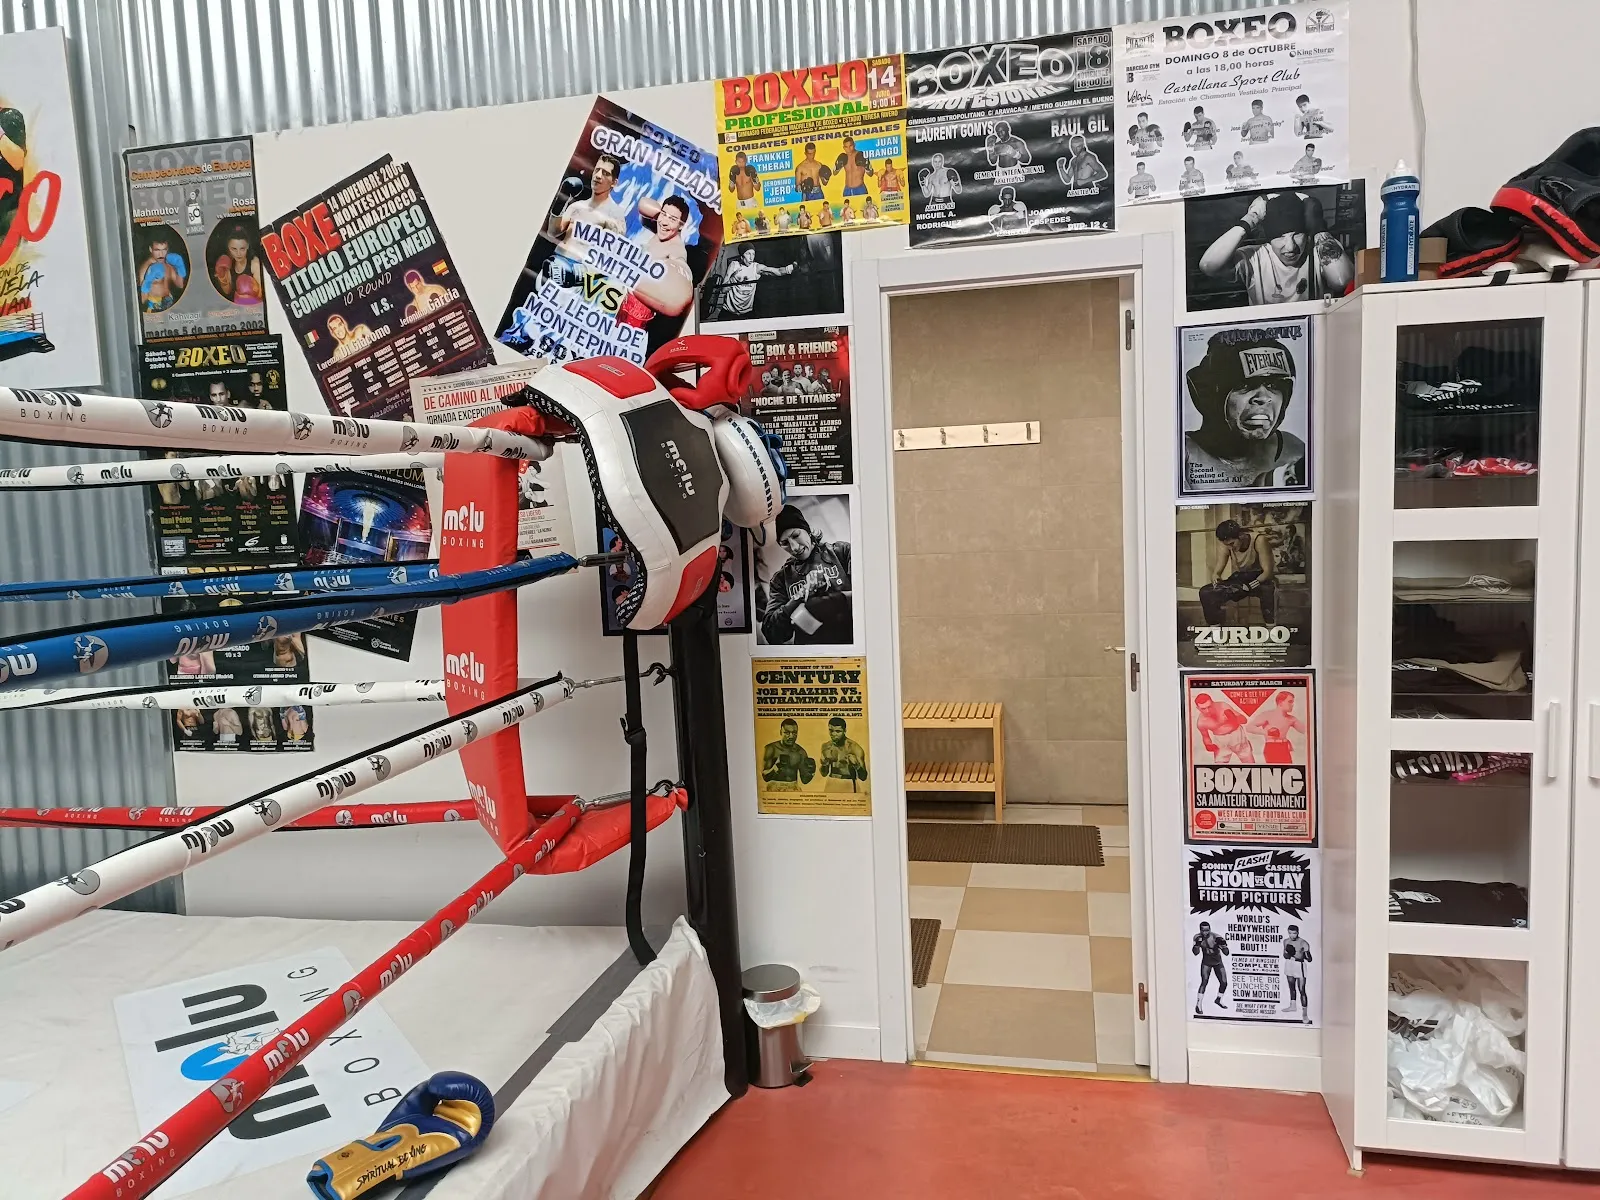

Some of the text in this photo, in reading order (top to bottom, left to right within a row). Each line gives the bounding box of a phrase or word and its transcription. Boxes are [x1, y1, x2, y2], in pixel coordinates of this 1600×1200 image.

[1162, 12, 1296, 52] BOXEO
[1076, 45, 1110, 70] 18
[1166, 43, 1296, 64] DOMINGO 8 de OCTUBRE
[1296, 48, 1312, 57] King
[907, 44, 1074, 102] BOXEO
[1196, 64, 1210, 74] las
[1215, 61, 1242, 72] 18,00
[1245, 58, 1274, 69] horas
[868, 66, 896, 90] 14
[1164, 68, 1300, 94] Castellana Sport Club
[722, 60, 869, 117] BOXEO
[912, 83, 1072, 111] PROFESIONAL
[725, 100, 869, 130] PROFESIONAL
[908, 116, 936, 126] GIMNASIO
[937, 111, 985, 122] METROPOLITANO
[1054, 100, 1082, 108] GUZMAN
[726, 124, 900, 152] COMBATES INTERNACIONALES
[916, 122, 995, 143] LAURENT GOMYS
[1051, 119, 1110, 138] RAUL GIL
[643, 123, 700, 164] BOXEO
[876, 136, 898, 148] JUAN
[747, 150, 790, 164] FRANKKIE
[862, 146, 899, 159] URANGO
[130, 160, 251, 181] Campeonatos de Europa
[592, 127, 722, 212] GRAN VELADA
[757, 159, 791, 172] THERAN
[327, 195, 339, 213] 14
[336, 170, 382, 207] NOVEMBRE
[333, 173, 411, 228] MONTESILVANO
[764, 196, 785, 204] GARCIA
[232, 197, 256, 207] Rosa
[133, 206, 180, 218] Mahmutov
[339, 188, 416, 242] PALAMAZZOCCO
[916, 212, 946, 220] MIGUEL
[1028, 216, 1071, 226] CESPEDES
[916, 219, 962, 230] RODRIGUEZ
[260, 202, 342, 280] BOXE
[574, 221, 666, 280] MARTILLO
[281, 204, 428, 301] TITOLO EUROPEO
[290, 226, 438, 320] COMUNITARIO PESI MEDI
[585, 248, 642, 288] SMITH
[344, 271, 394, 306] 10 ROUND
[584, 272, 624, 314] VS
[426, 286, 460, 312] Garcia
[540, 284, 646, 350] EL LEÓN DE
[145, 320, 264, 338] martes 5 de marzo 2002
[175, 344, 247, 368] BOXEO
[750, 343, 764, 354] 02
[766, 341, 838, 356] BOX & FRIENDS
[1244, 351, 1288, 374] EVERLAST
[424, 396, 436, 410] DE
[439, 389, 477, 408] CAMINO
[480, 388, 492, 402] AL
[786, 396, 798, 404] DE
[20, 408, 87, 423] BOXING
[202, 424, 248, 436] BOXING
[330, 438, 368, 449] BOXING
[442, 536, 484, 549] BOXING
[174, 618, 230, 633] BOXING
[756, 670, 861, 684] CENTURY
[446, 679, 484, 700] BOXING
[756, 688, 778, 696] JOE
[840, 687, 862, 695] VS.
[756, 696, 862, 704] MUHAMMAD ALI
[1196, 768, 1304, 794] BOXING
[1196, 794, 1306, 808] SA AMATEUR TOURNAMENT
[1218, 810, 1234, 818] WEST
[1235, 810, 1260, 818] ADELAIDE
[1236, 852, 1270, 868] FLASH!
[1198, 870, 1254, 888] LISTON
[1264, 872, 1304, 890] CLAY
[1200, 890, 1302, 904] FIGHT PICTURES
[1228, 924, 1280, 933] HEAVYWEIGHT
[1236, 914, 1270, 924] WORLD'S
[1225, 933, 1283, 942] CHAMPIONSHIP
[1240, 943, 1268, 952] BOUT!!
[1232, 982, 1270, 990] PUNCHES
[1252, 990, 1280, 998] MOTION!
[116, 1148, 176, 1198] BOXING
[356, 1158, 398, 1190] SPIRITUAL
